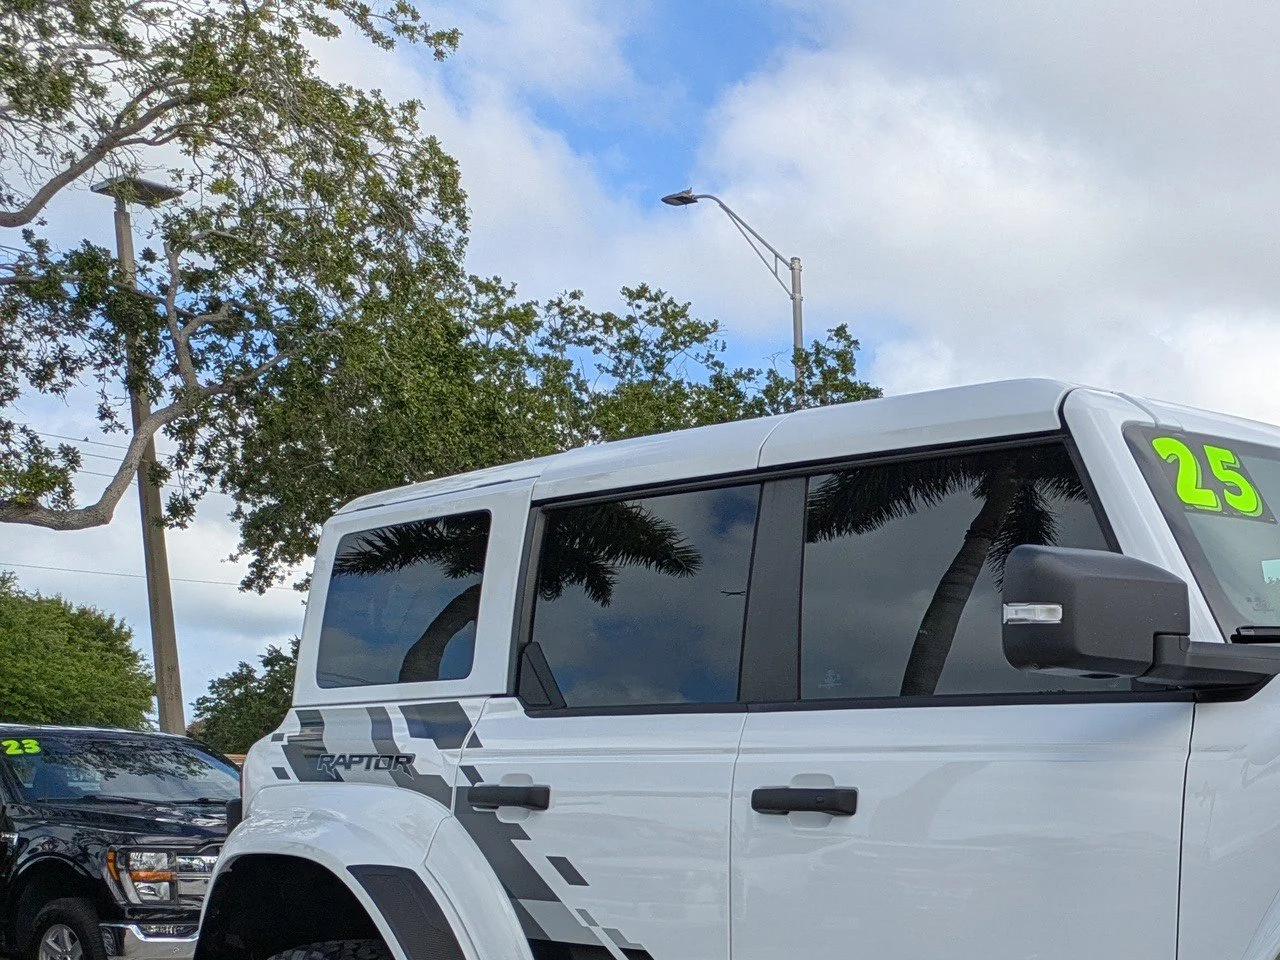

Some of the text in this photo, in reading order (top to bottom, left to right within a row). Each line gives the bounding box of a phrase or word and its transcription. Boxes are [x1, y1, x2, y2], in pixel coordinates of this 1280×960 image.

[1151, 437, 1263, 517] 25
[1, 739, 41, 755] 23
[317, 753, 416, 780] RAPTOR
